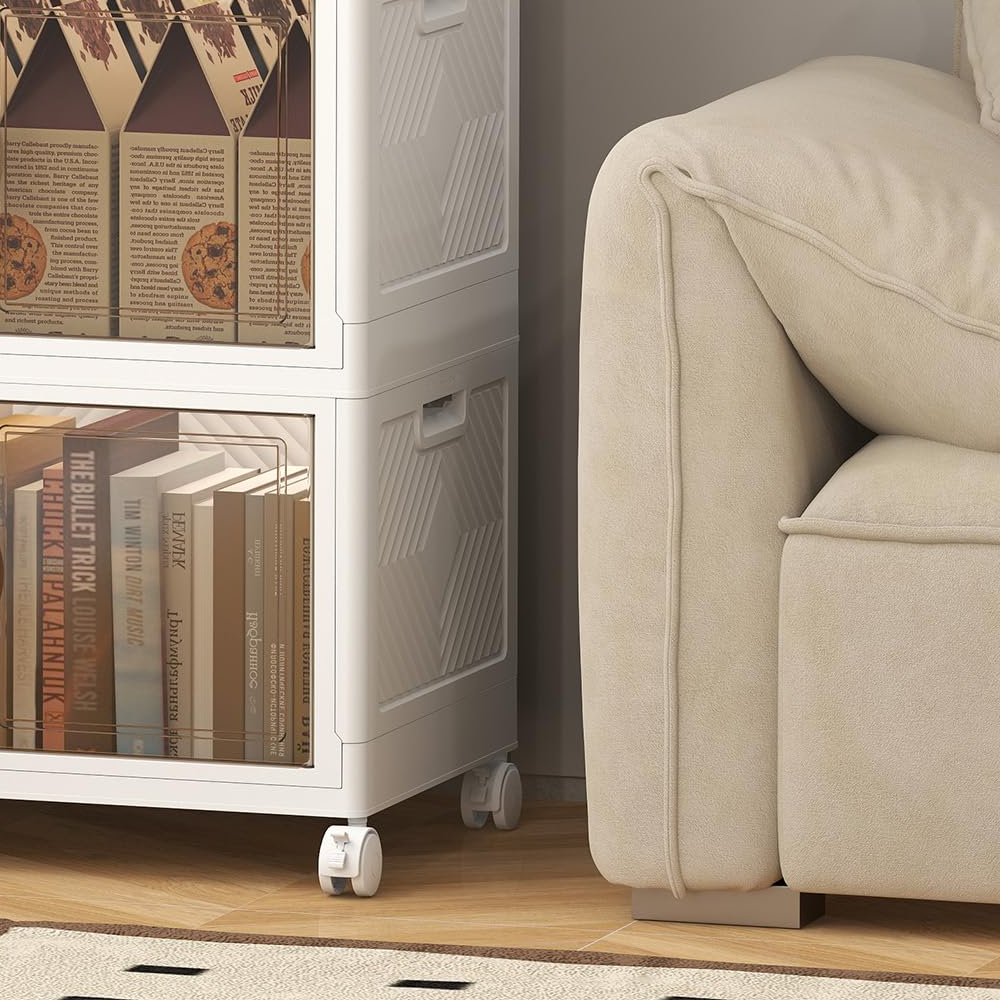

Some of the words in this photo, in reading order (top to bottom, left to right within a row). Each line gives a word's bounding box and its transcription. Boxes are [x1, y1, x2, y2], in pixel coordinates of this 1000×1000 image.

[70, 450, 96, 480] THE
[43, 477, 64, 550] CHUCK
[70, 483, 96, 540] BULLET
[124, 498, 141, 520] TIM
[71, 544, 96, 592] TRICK
[125, 525, 142, 572] WINTON
[126, 574, 143, 602] DIRT
[43, 580, 64, 704] PALAHNIUK
[72, 596, 97, 654] LOUISE
[126, 606, 144, 647] MUSIC
[72, 658, 97, 711] WELSH
